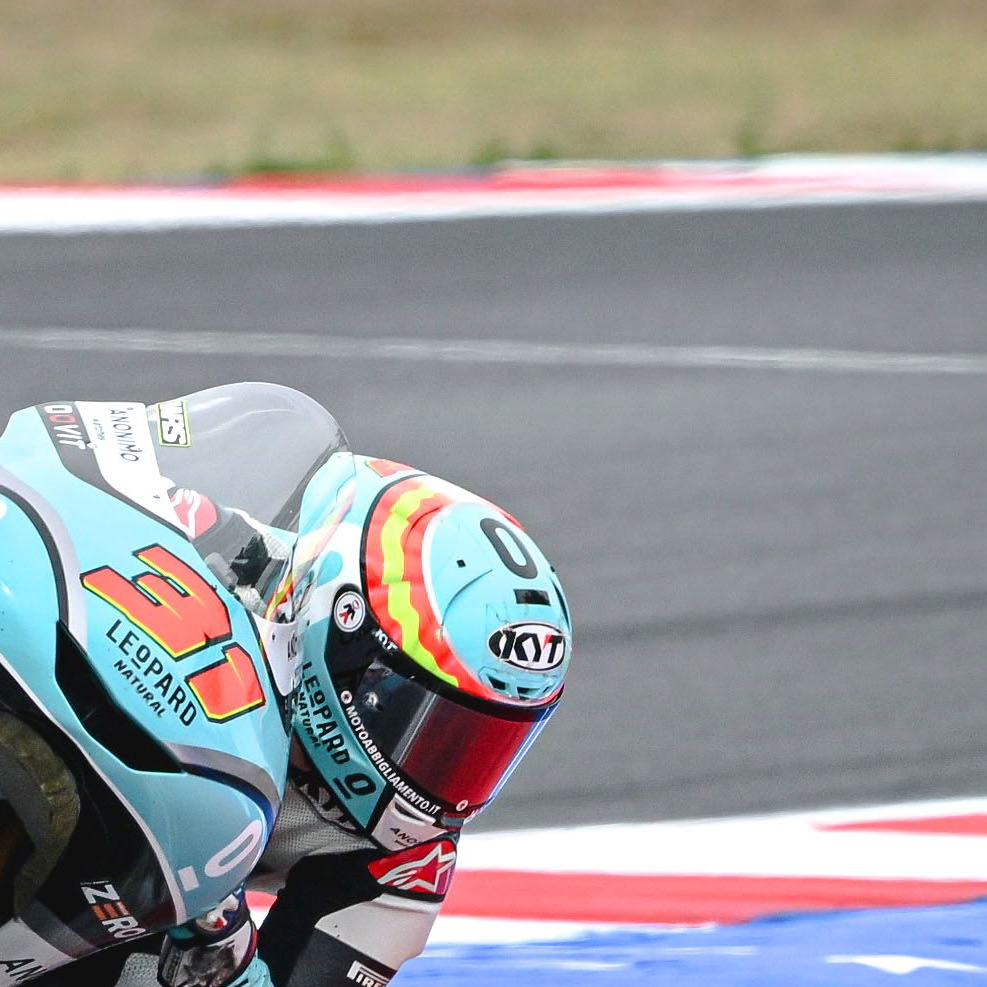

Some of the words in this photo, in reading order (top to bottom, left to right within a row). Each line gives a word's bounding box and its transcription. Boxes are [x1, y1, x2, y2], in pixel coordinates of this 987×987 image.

[110, 409, 143, 461] ANONIMO
[80, 543, 265, 723] 31
[105, 619, 197, 726] LEOPARD
[499, 629, 564, 666] KYT
[113, 660, 167, 718] NATURAL
[301, 661, 351, 765] LEOPARD
[345, 704, 441, 815] MOTOABBIGLIAMENTO.IT
[81, 884, 146, 938] ZERO
